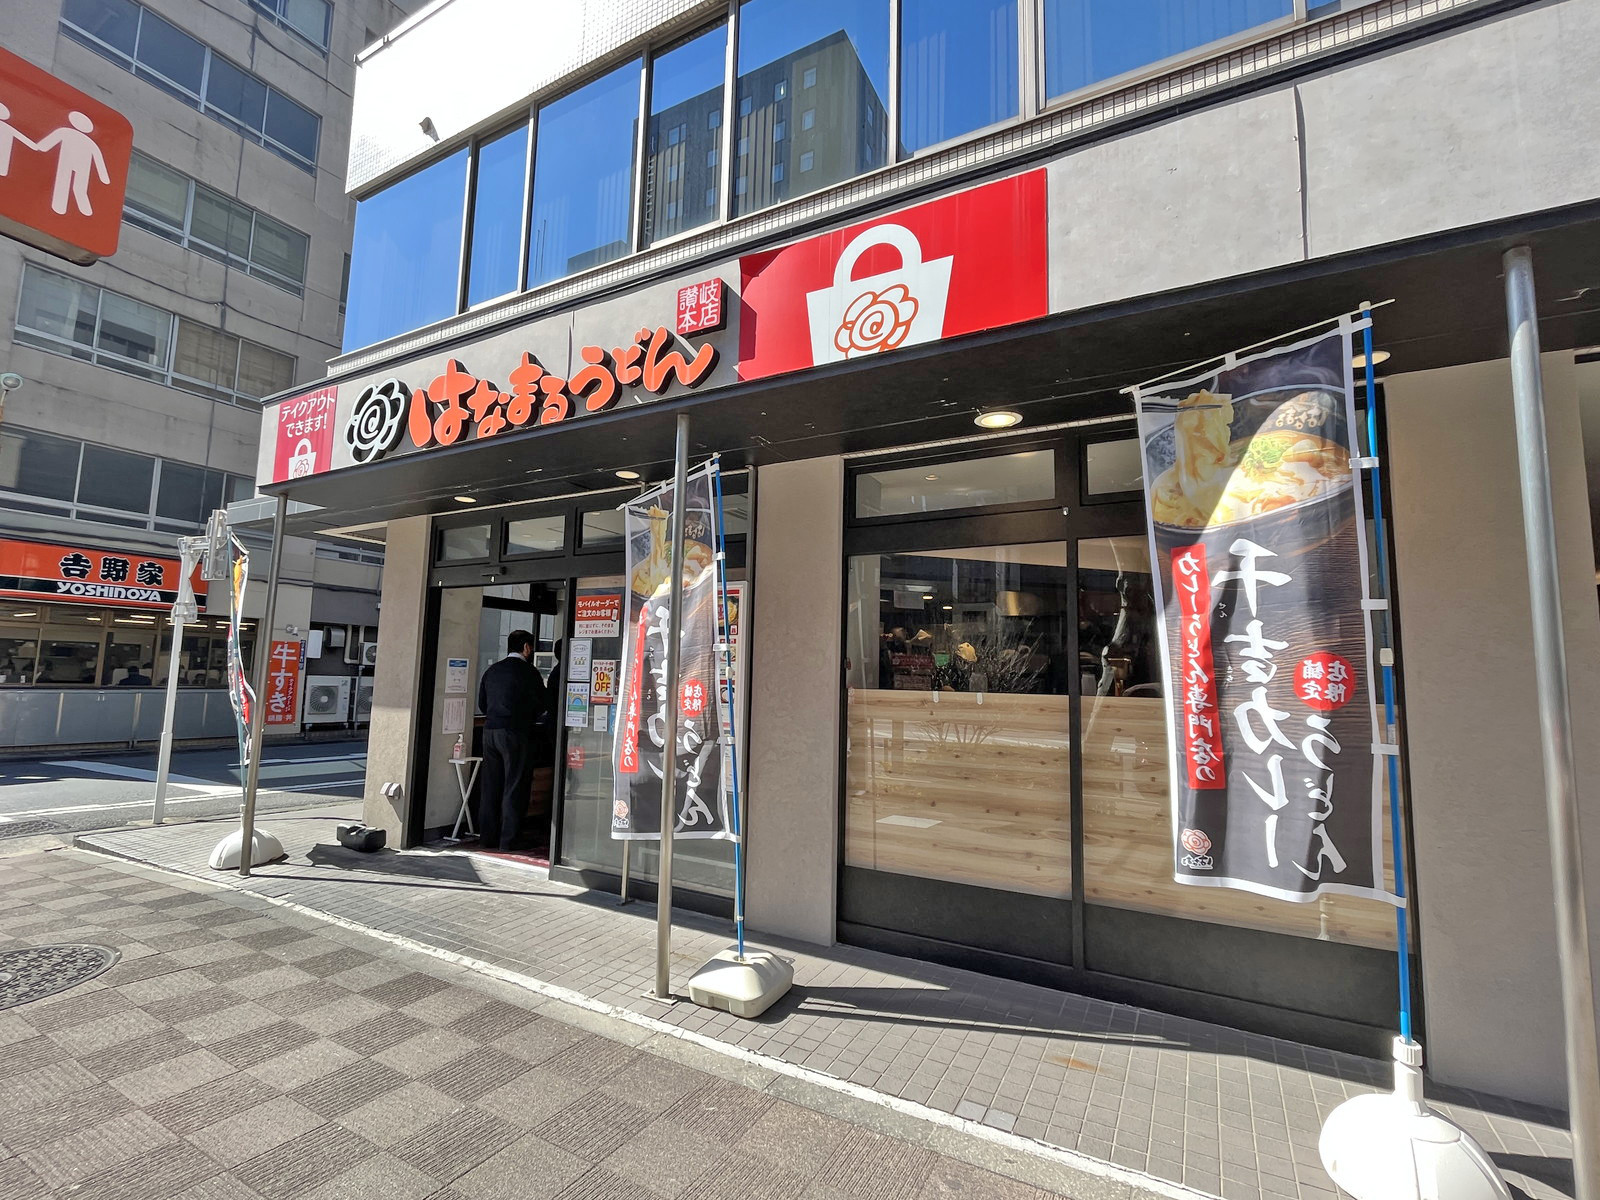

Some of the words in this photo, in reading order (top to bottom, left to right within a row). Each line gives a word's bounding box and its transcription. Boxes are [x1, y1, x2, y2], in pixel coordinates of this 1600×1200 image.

[408, 325, 716, 448] はなまるうどん
[281, 393, 335, 422] テイクアウト
[56, 582, 161, 601] YOSHINOYA
[269, 643, 297, 713] 牛すき
[594, 682, 611, 692] OFF
[595, 671, 611, 681] 10%
